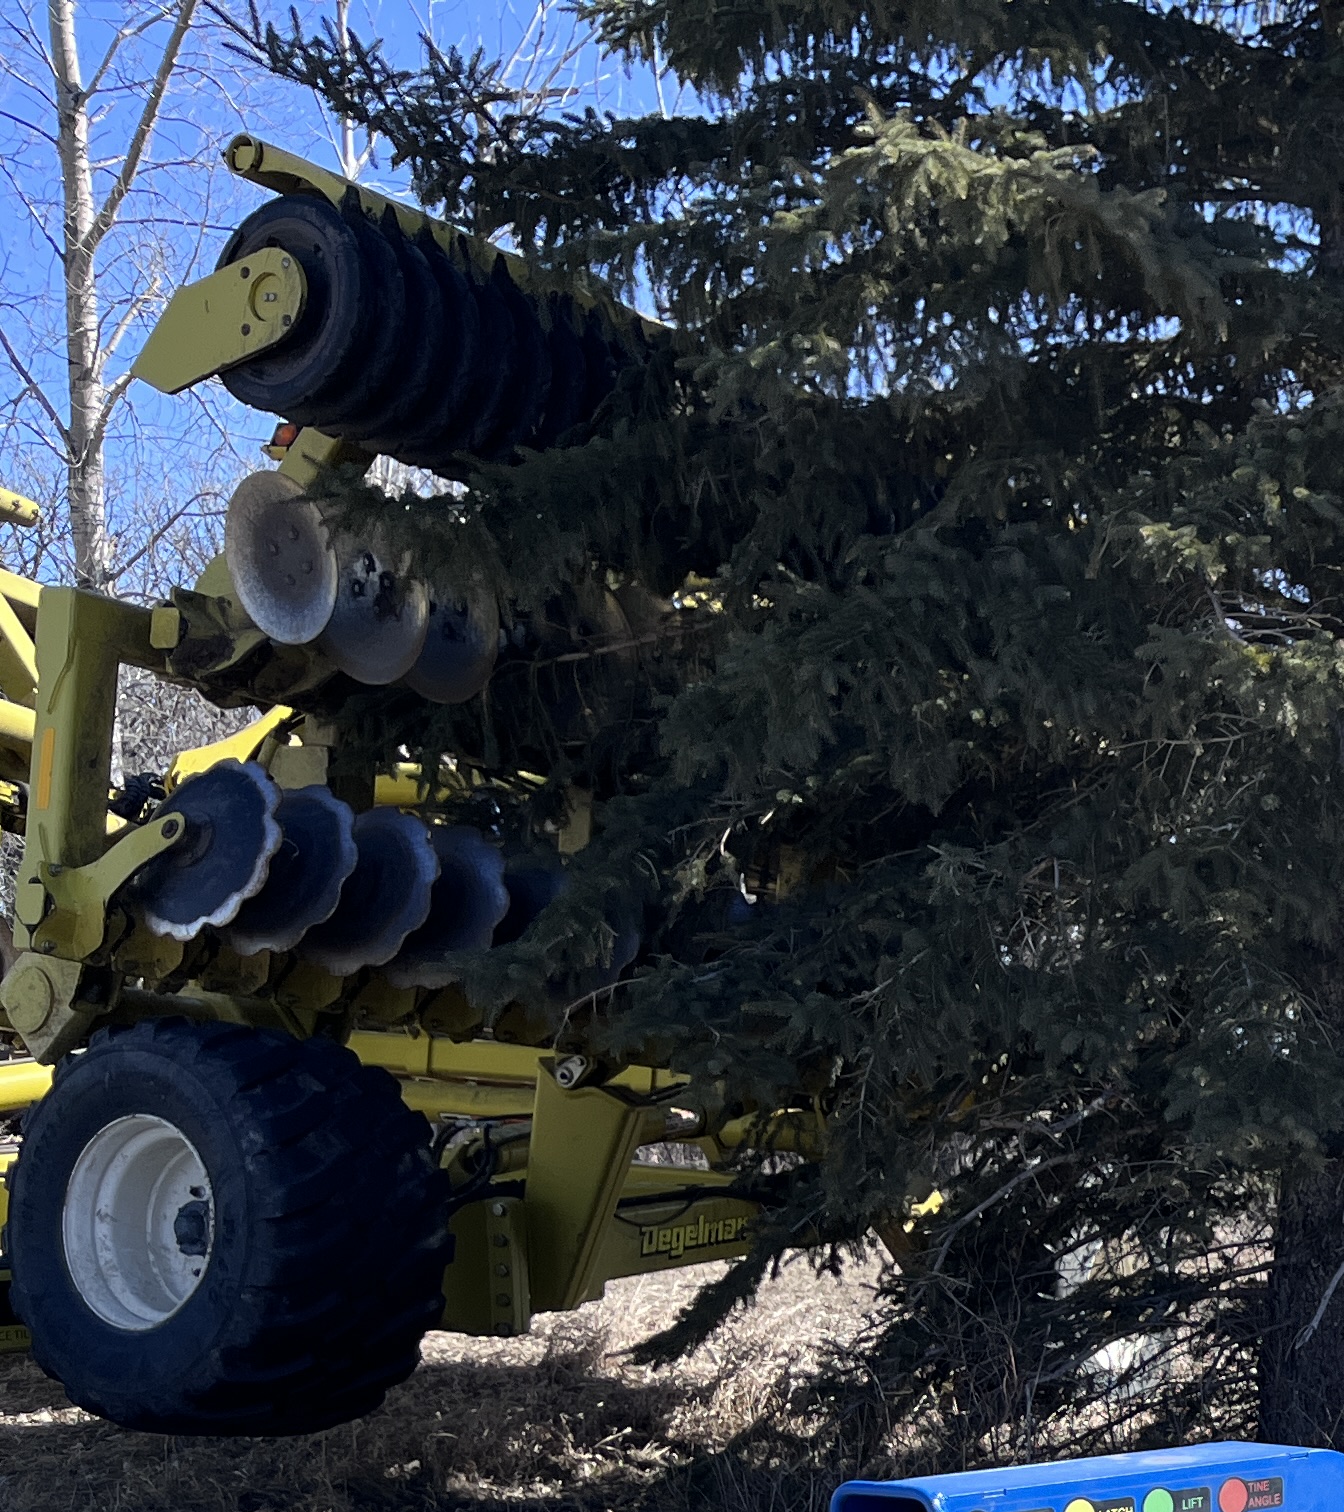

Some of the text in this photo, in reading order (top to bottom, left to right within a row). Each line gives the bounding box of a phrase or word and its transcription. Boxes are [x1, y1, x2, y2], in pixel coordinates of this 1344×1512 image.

[1247, 1480, 1270, 1493] TINE
[1182, 1496, 1204, 1511] LIFT
[1247, 1492, 1281, 1508] ANGLE
